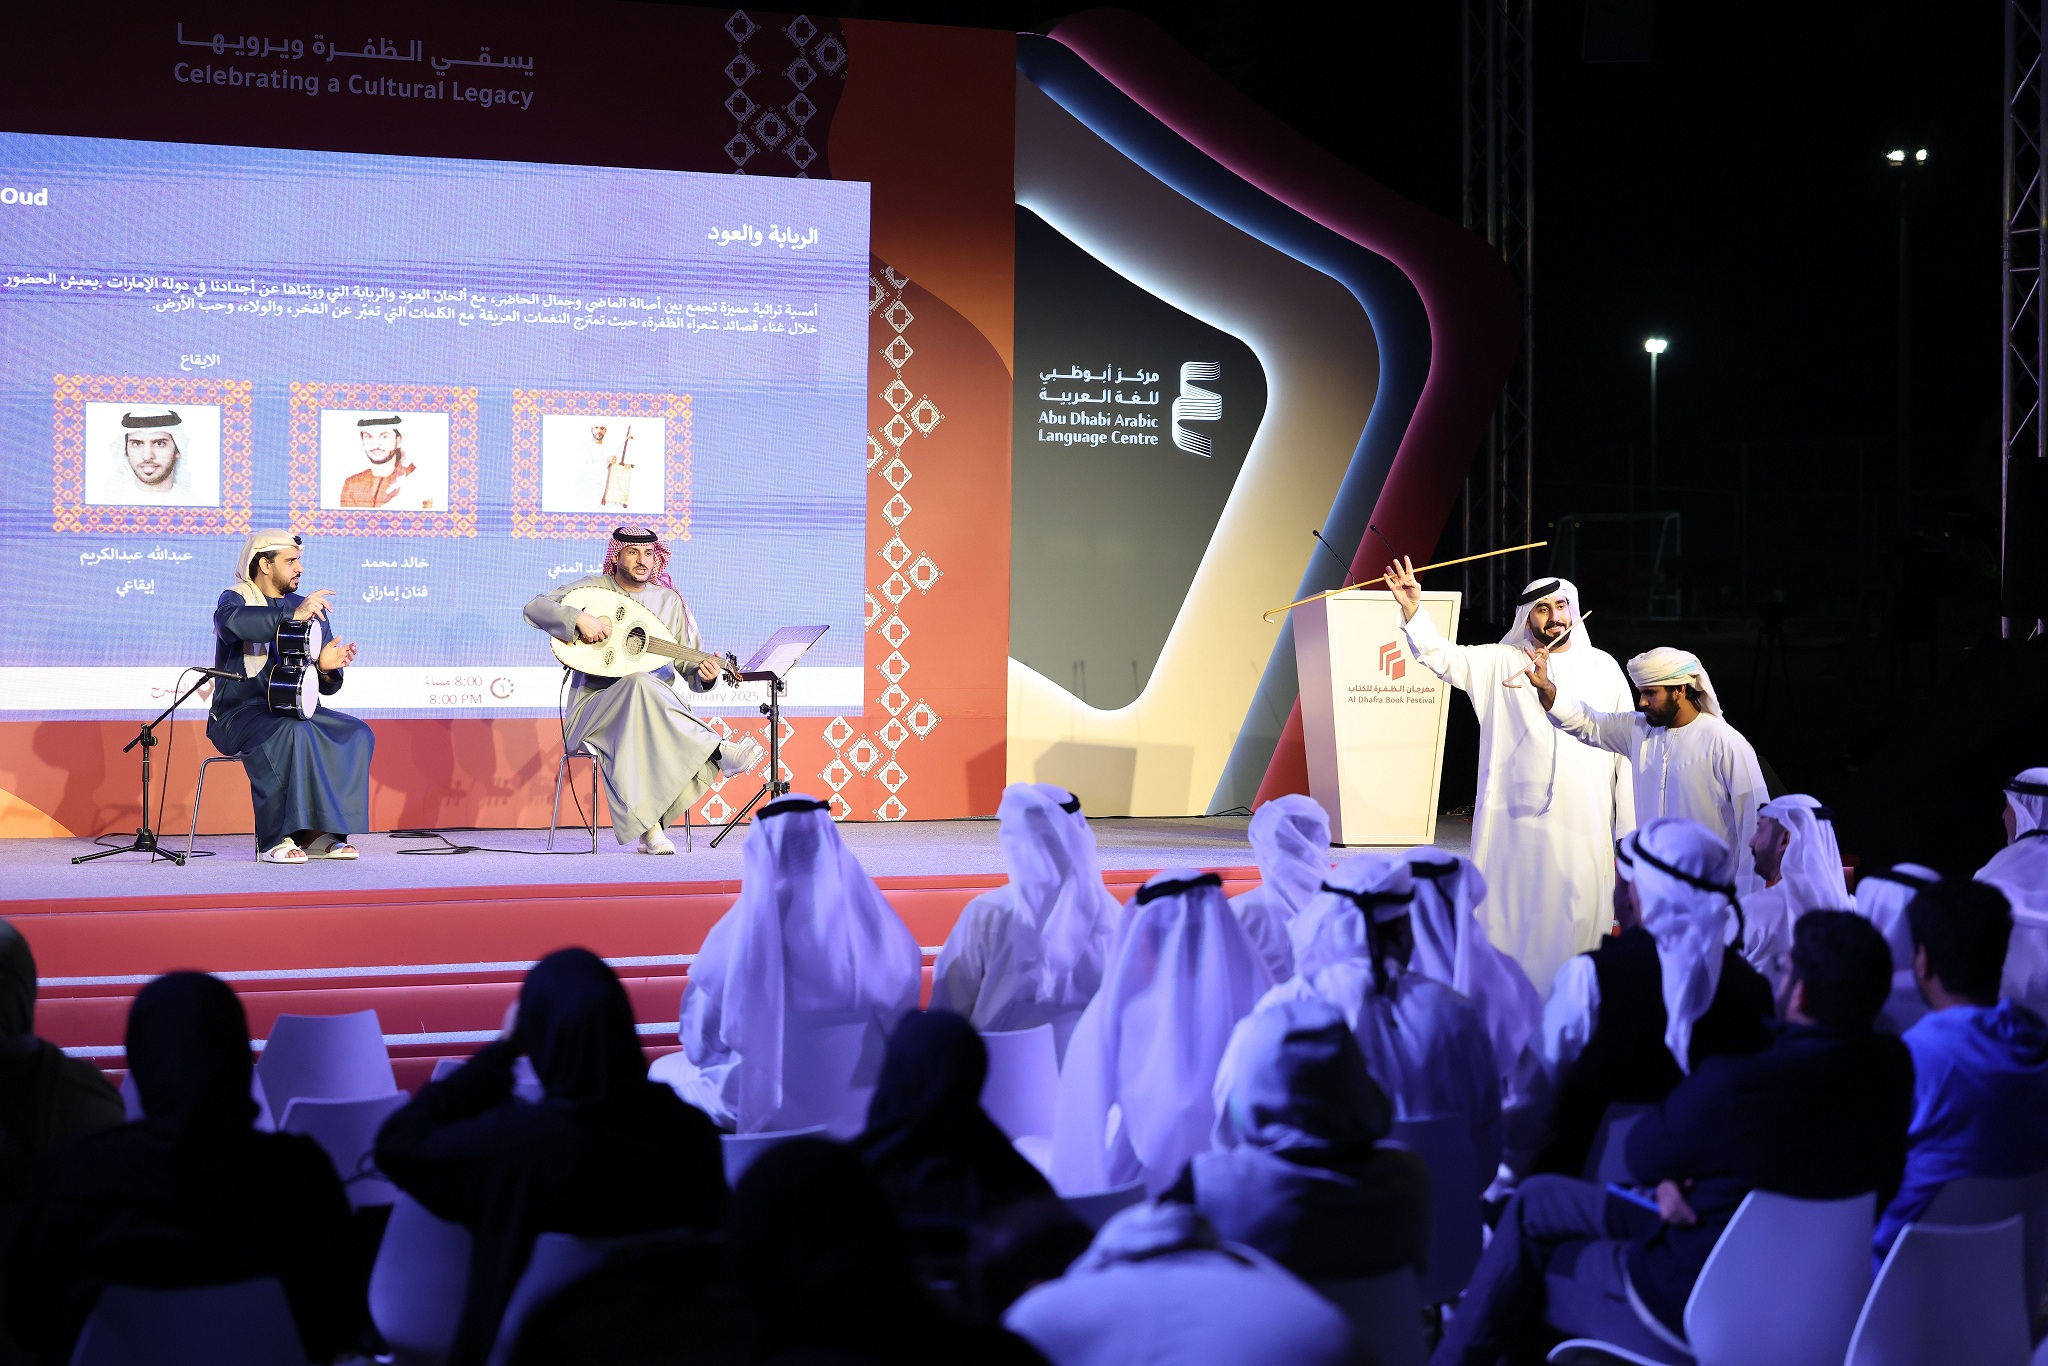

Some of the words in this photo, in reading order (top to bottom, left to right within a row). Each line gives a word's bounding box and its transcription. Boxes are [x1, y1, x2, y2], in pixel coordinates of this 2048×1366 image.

[178, 23, 303, 59] ويرويها
[313, 35, 422, 62] الظفرة
[431, 46, 534, 77] يسقي
[174, 62, 319, 96] Celebrating
[327, 75, 340, 93] a
[348, 74, 444, 99] Cultural
[452, 81, 534, 110] Legacy
[1, 187, 48, 206] Oud
[707, 223, 763, 247] والعود
[768, 224, 818, 250] الربابة
[3, 272, 56, 288] الحضور
[107, 276, 158, 293] الإمارات
[161, 277, 189, 294] دولة
[193, 279, 206, 297] في
[211, 278, 255, 295] أجدادنا
[259, 284, 280, 297] عن
[283, 283, 324, 299] ورثناها
[326, 285, 349, 303] التي
[353, 285, 395, 302] والربابة
[399, 288, 430, 304] العود
[433, 288, 467, 303] ألحان
[152, 295, 194, 312] الأرض.
[198, 302, 234, 314] وحب
[237, 300, 283, 316] والولاء،
[470, 295, 486, 308] مع
[490, 293, 539, 307] الحاضر،
[542, 294, 581, 310] وجمال
[585, 297, 626, 313] الماضي
[629, 296, 661, 310] أصالة
[287, 302, 328, 318] الفخر،
[332, 306, 352, 318] عن
[384, 306, 406, 324] التي
[408, 306, 455, 319] الكلمات
[664, 303, 683, 314] بين
[685, 302, 717, 317] تجمع
[720, 302, 749, 316] مميزة
[753, 303, 782, 319] تراثية
[785, 303, 818, 319] أمسية
[458, 312, 474, 326] مع
[479, 309, 520, 326] العريقة
[523, 312, 570, 324] النغمات
[573, 315, 606, 330] تمتزج
[607, 316, 638, 330] حيث
[641, 316, 684, 332] الظفرة،
[687, 318, 720, 333] شعراء
[723, 320, 758, 332] قصائد
[762, 321, 785, 333] غناء
[788, 322, 818, 335] خلال
[1039, 364, 1112, 385] أبوظبي
[1115, 367, 1160, 385] مركز
[1039, 387, 1112, 405] العربية
[1115, 389, 1159, 405] للغة
[1038, 410, 1066, 425] Abu
[1070, 411, 1111, 426] Dhabi
[1114, 413, 1158, 428] Arabic
[1038, 429, 1107, 447] Language
[1111, 431, 1159, 445] Centre
[80, 547, 143, 566] عبدالكريم
[147, 545, 193, 564] عبدالله
[400, 556, 430, 568] خالد
[361, 558, 398, 568] محمد
[548, 561, 583, 580] المنعي
[115, 579, 155, 597] إيقاعي
[362, 585, 399, 603] إماراتي
[401, 585, 429, 599] فنان
[454, 676, 483, 687] 8:00
[1348, 684, 1373, 694] للكتاب
[1374, 685, 1405, 694] الظفرة
[1406, 685, 1435, 694] مهرجان
[429, 694, 458, 705] 8:00
[461, 694, 482, 704] PM
[730, 691, 759, 702] 2025
[1358, 695, 1383, 704] Dhafra
[1385, 696, 1405, 704] Book
[1406, 696, 1435, 704] Festival
